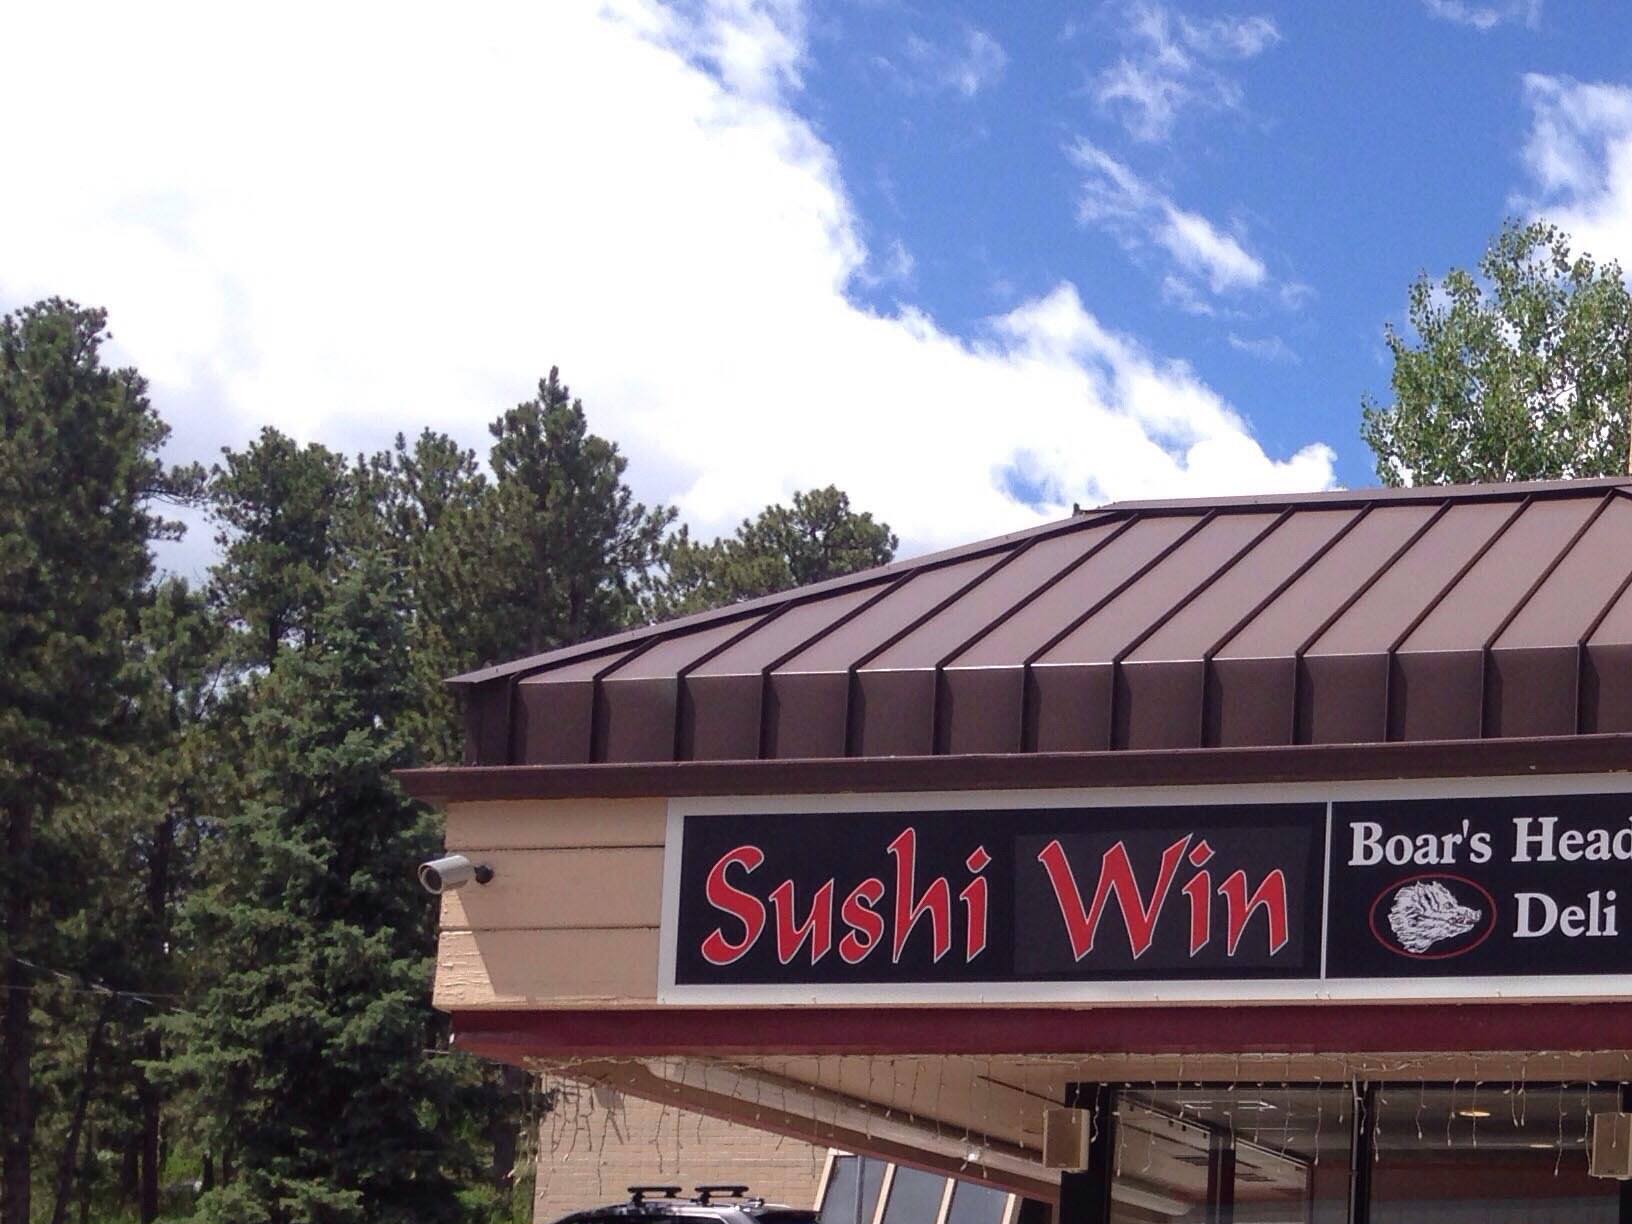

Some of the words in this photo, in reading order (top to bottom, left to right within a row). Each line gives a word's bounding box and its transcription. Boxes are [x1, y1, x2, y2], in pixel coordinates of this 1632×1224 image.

[1347, 818, 1493, 868] Boar's
[701, 826, 990, 966] Sushi
[1037, 832, 1290, 962] Win
[1512, 889, 1618, 940] Deli
